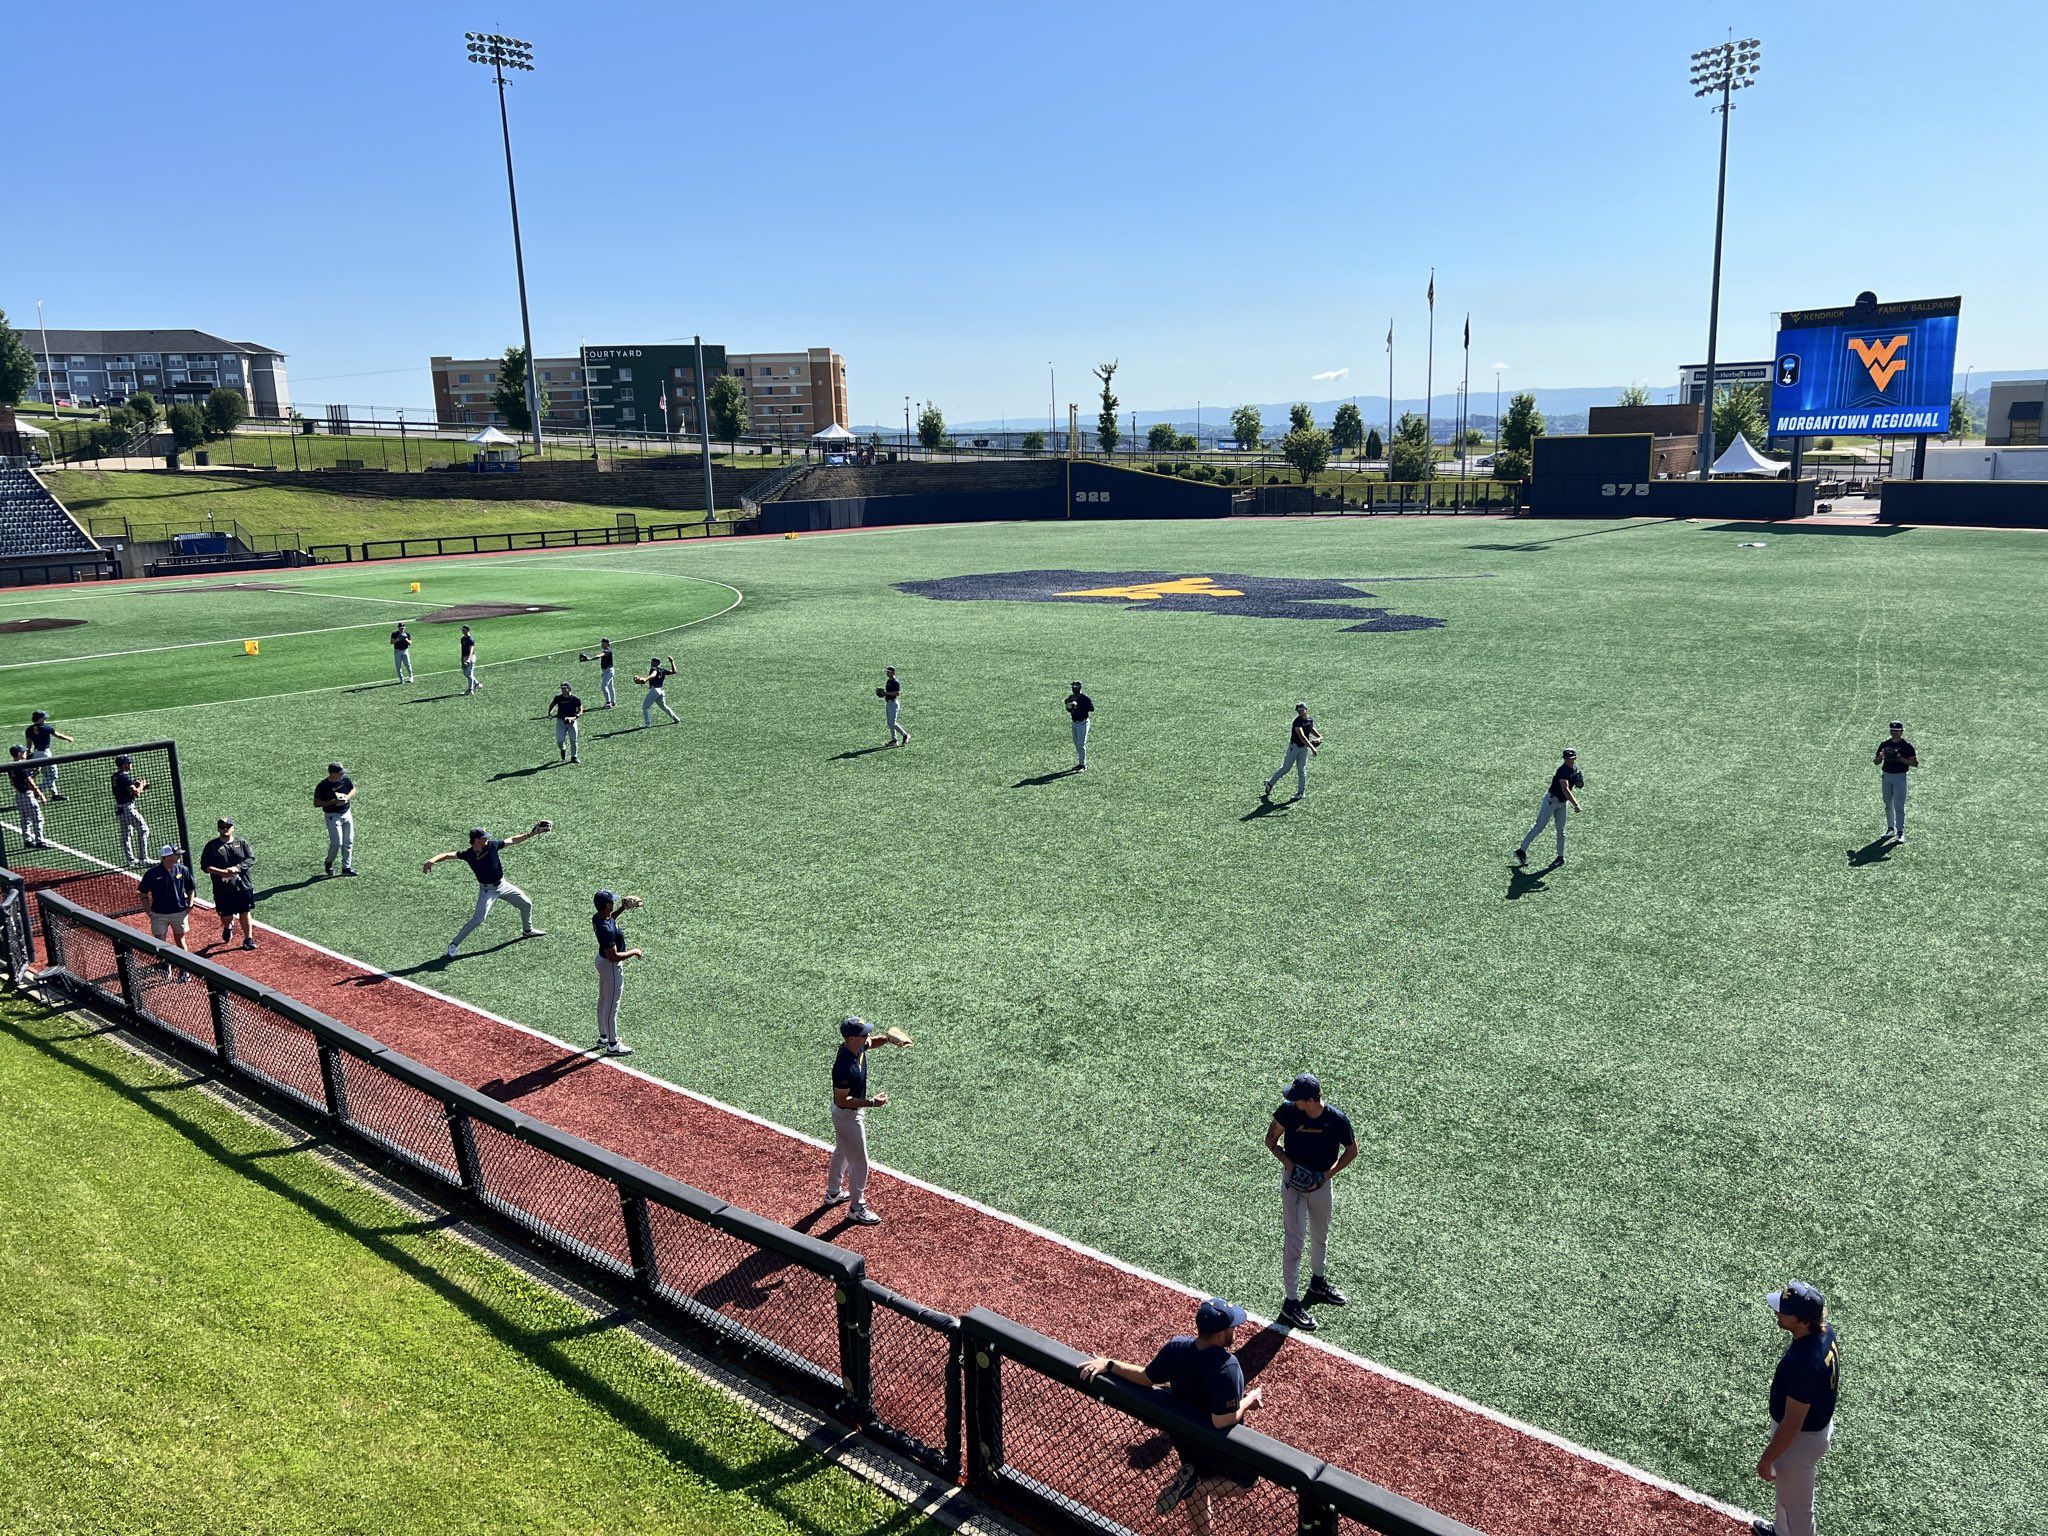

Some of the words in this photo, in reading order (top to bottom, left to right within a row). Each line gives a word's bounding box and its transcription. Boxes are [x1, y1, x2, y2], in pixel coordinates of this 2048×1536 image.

[1804, 311, 1845, 321] KENDRICK
[1878, 304, 1908, 315] FAMILY
[1911, 300, 1957, 312] BALLPARK
[1776, 414, 1869, 431] MORGANTOWN
[1871, 412, 1939, 429] REGIONAL
[1075, 491, 1110, 502] 325
[1601, 483, 1650, 496] 375
